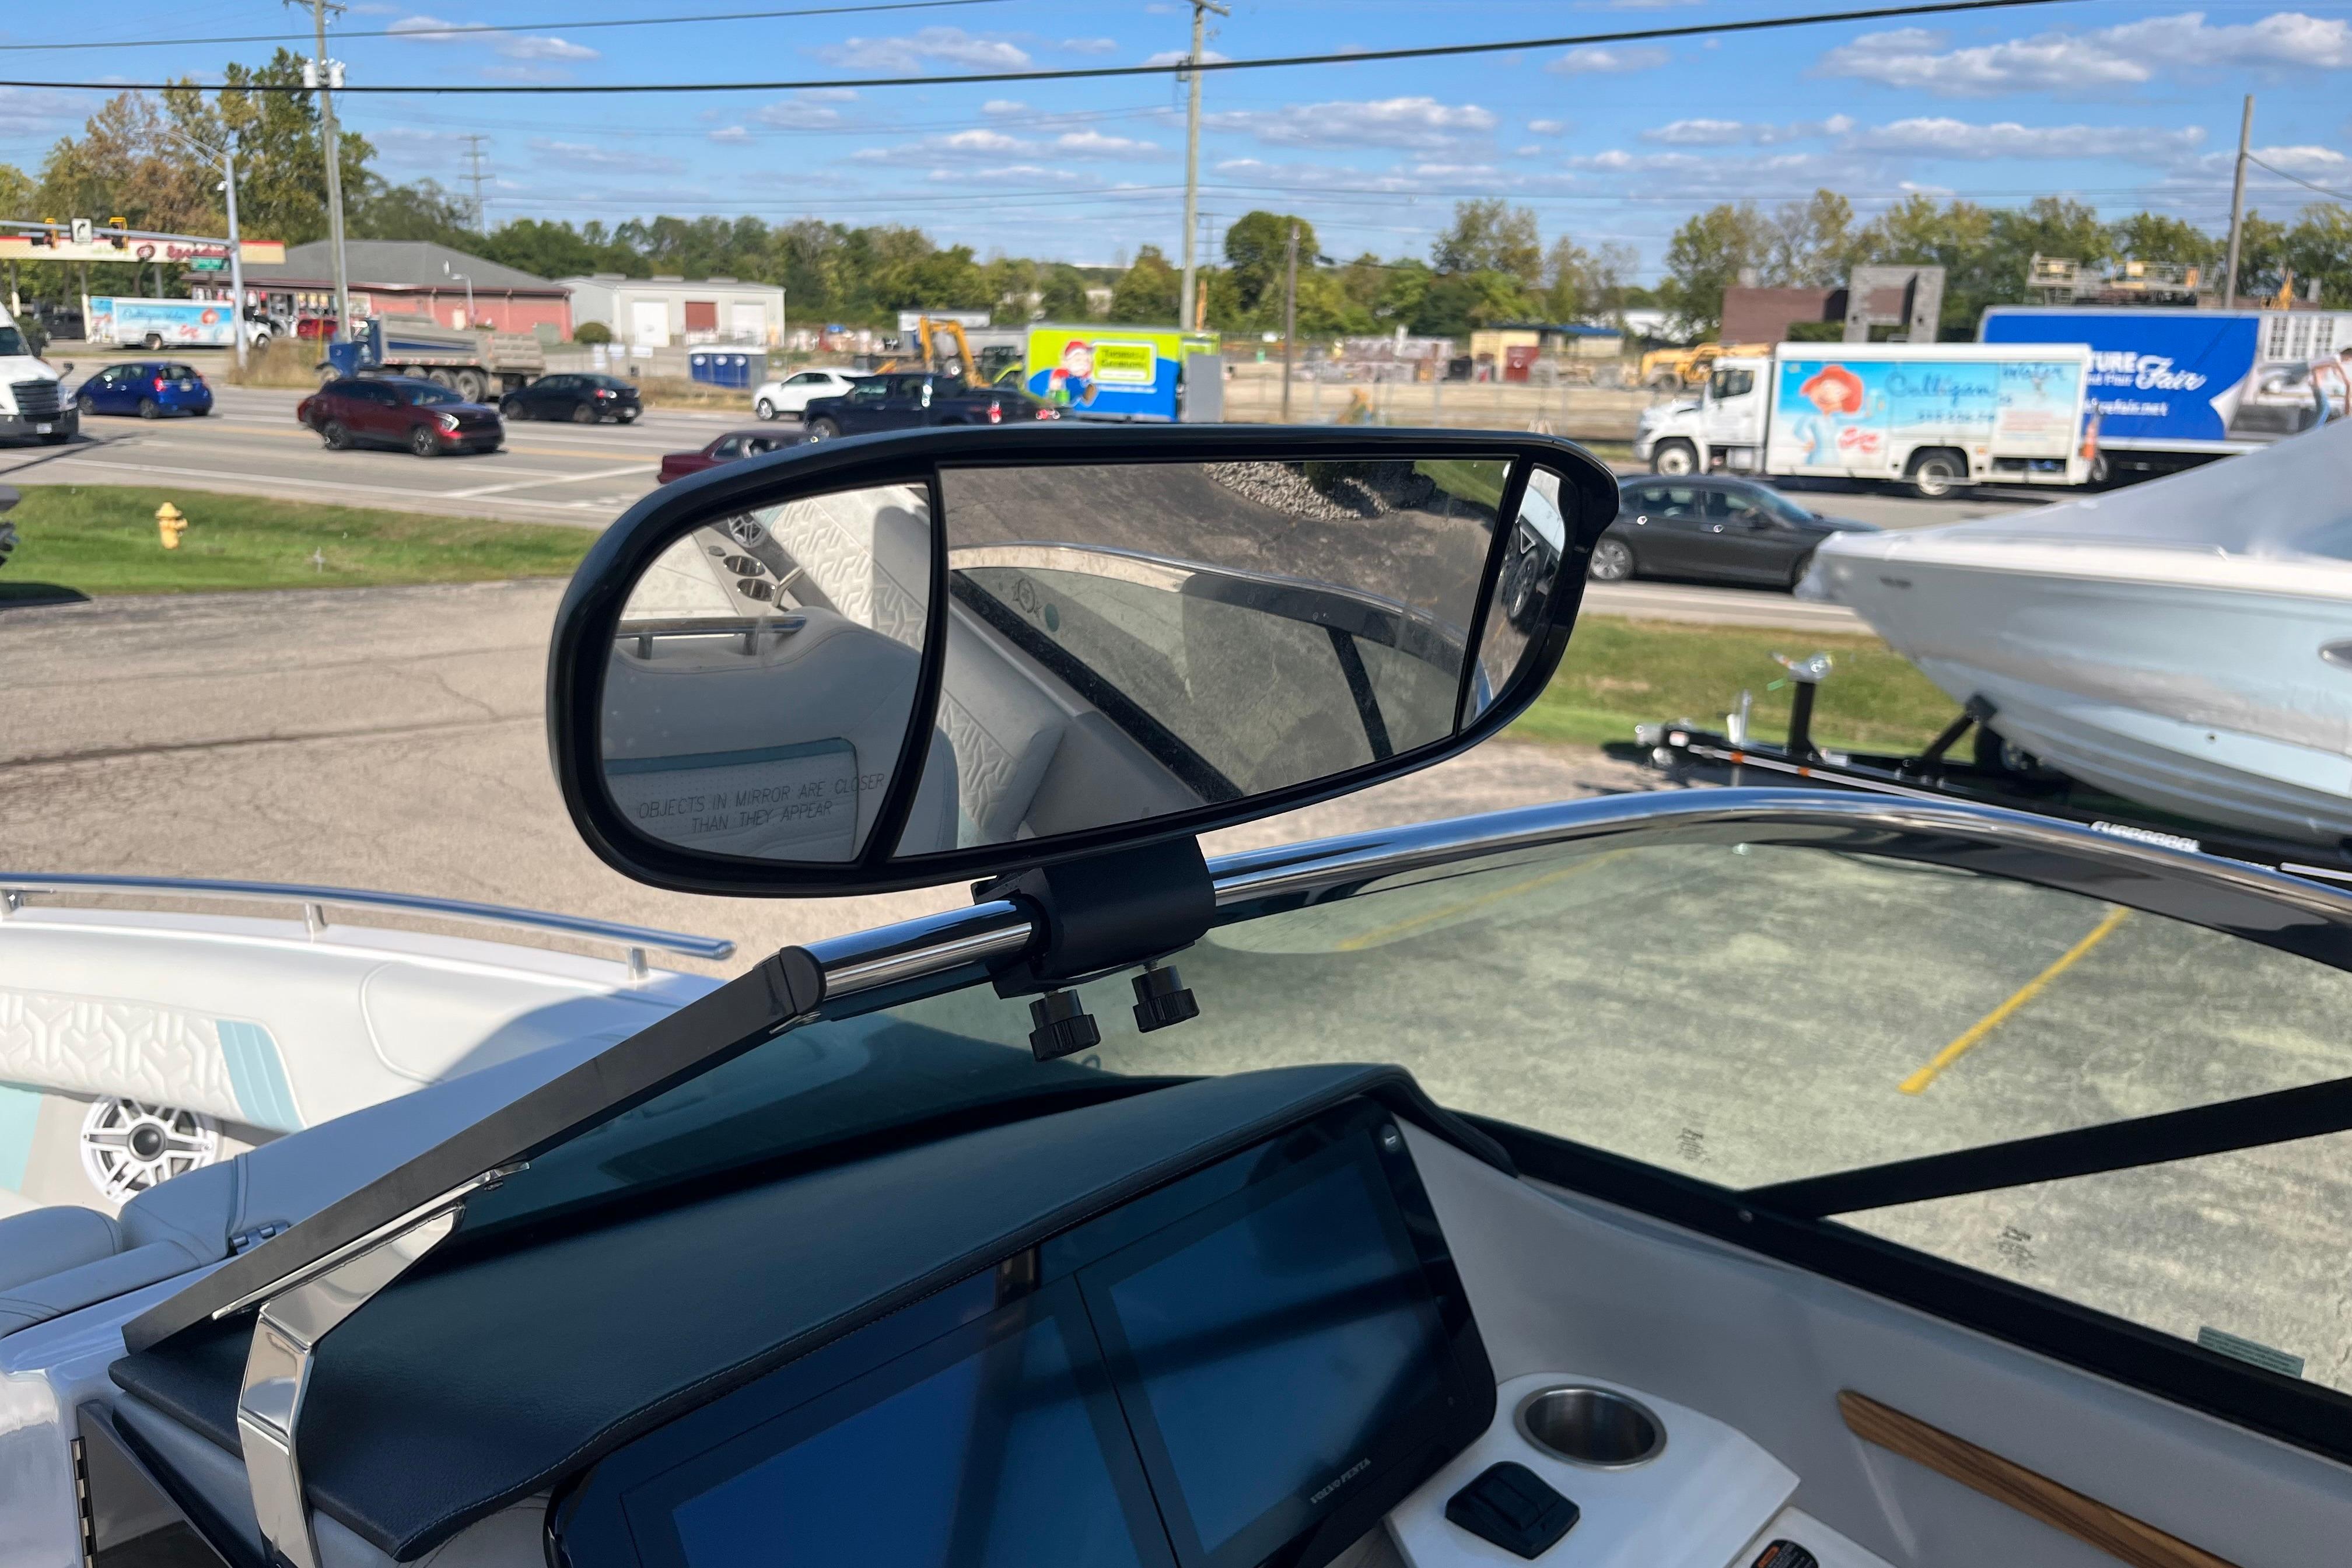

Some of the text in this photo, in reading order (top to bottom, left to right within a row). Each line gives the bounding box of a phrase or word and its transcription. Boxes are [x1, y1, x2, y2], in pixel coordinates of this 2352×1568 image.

[1885, 370, 1993, 407] Culligan
[2135, 355, 2208, 391] Fair
[639, 773, 886, 819] OBJECTS IN MIRROR ARE CLOSER
[692, 800, 834, 834] THAN THEY APPEAR
